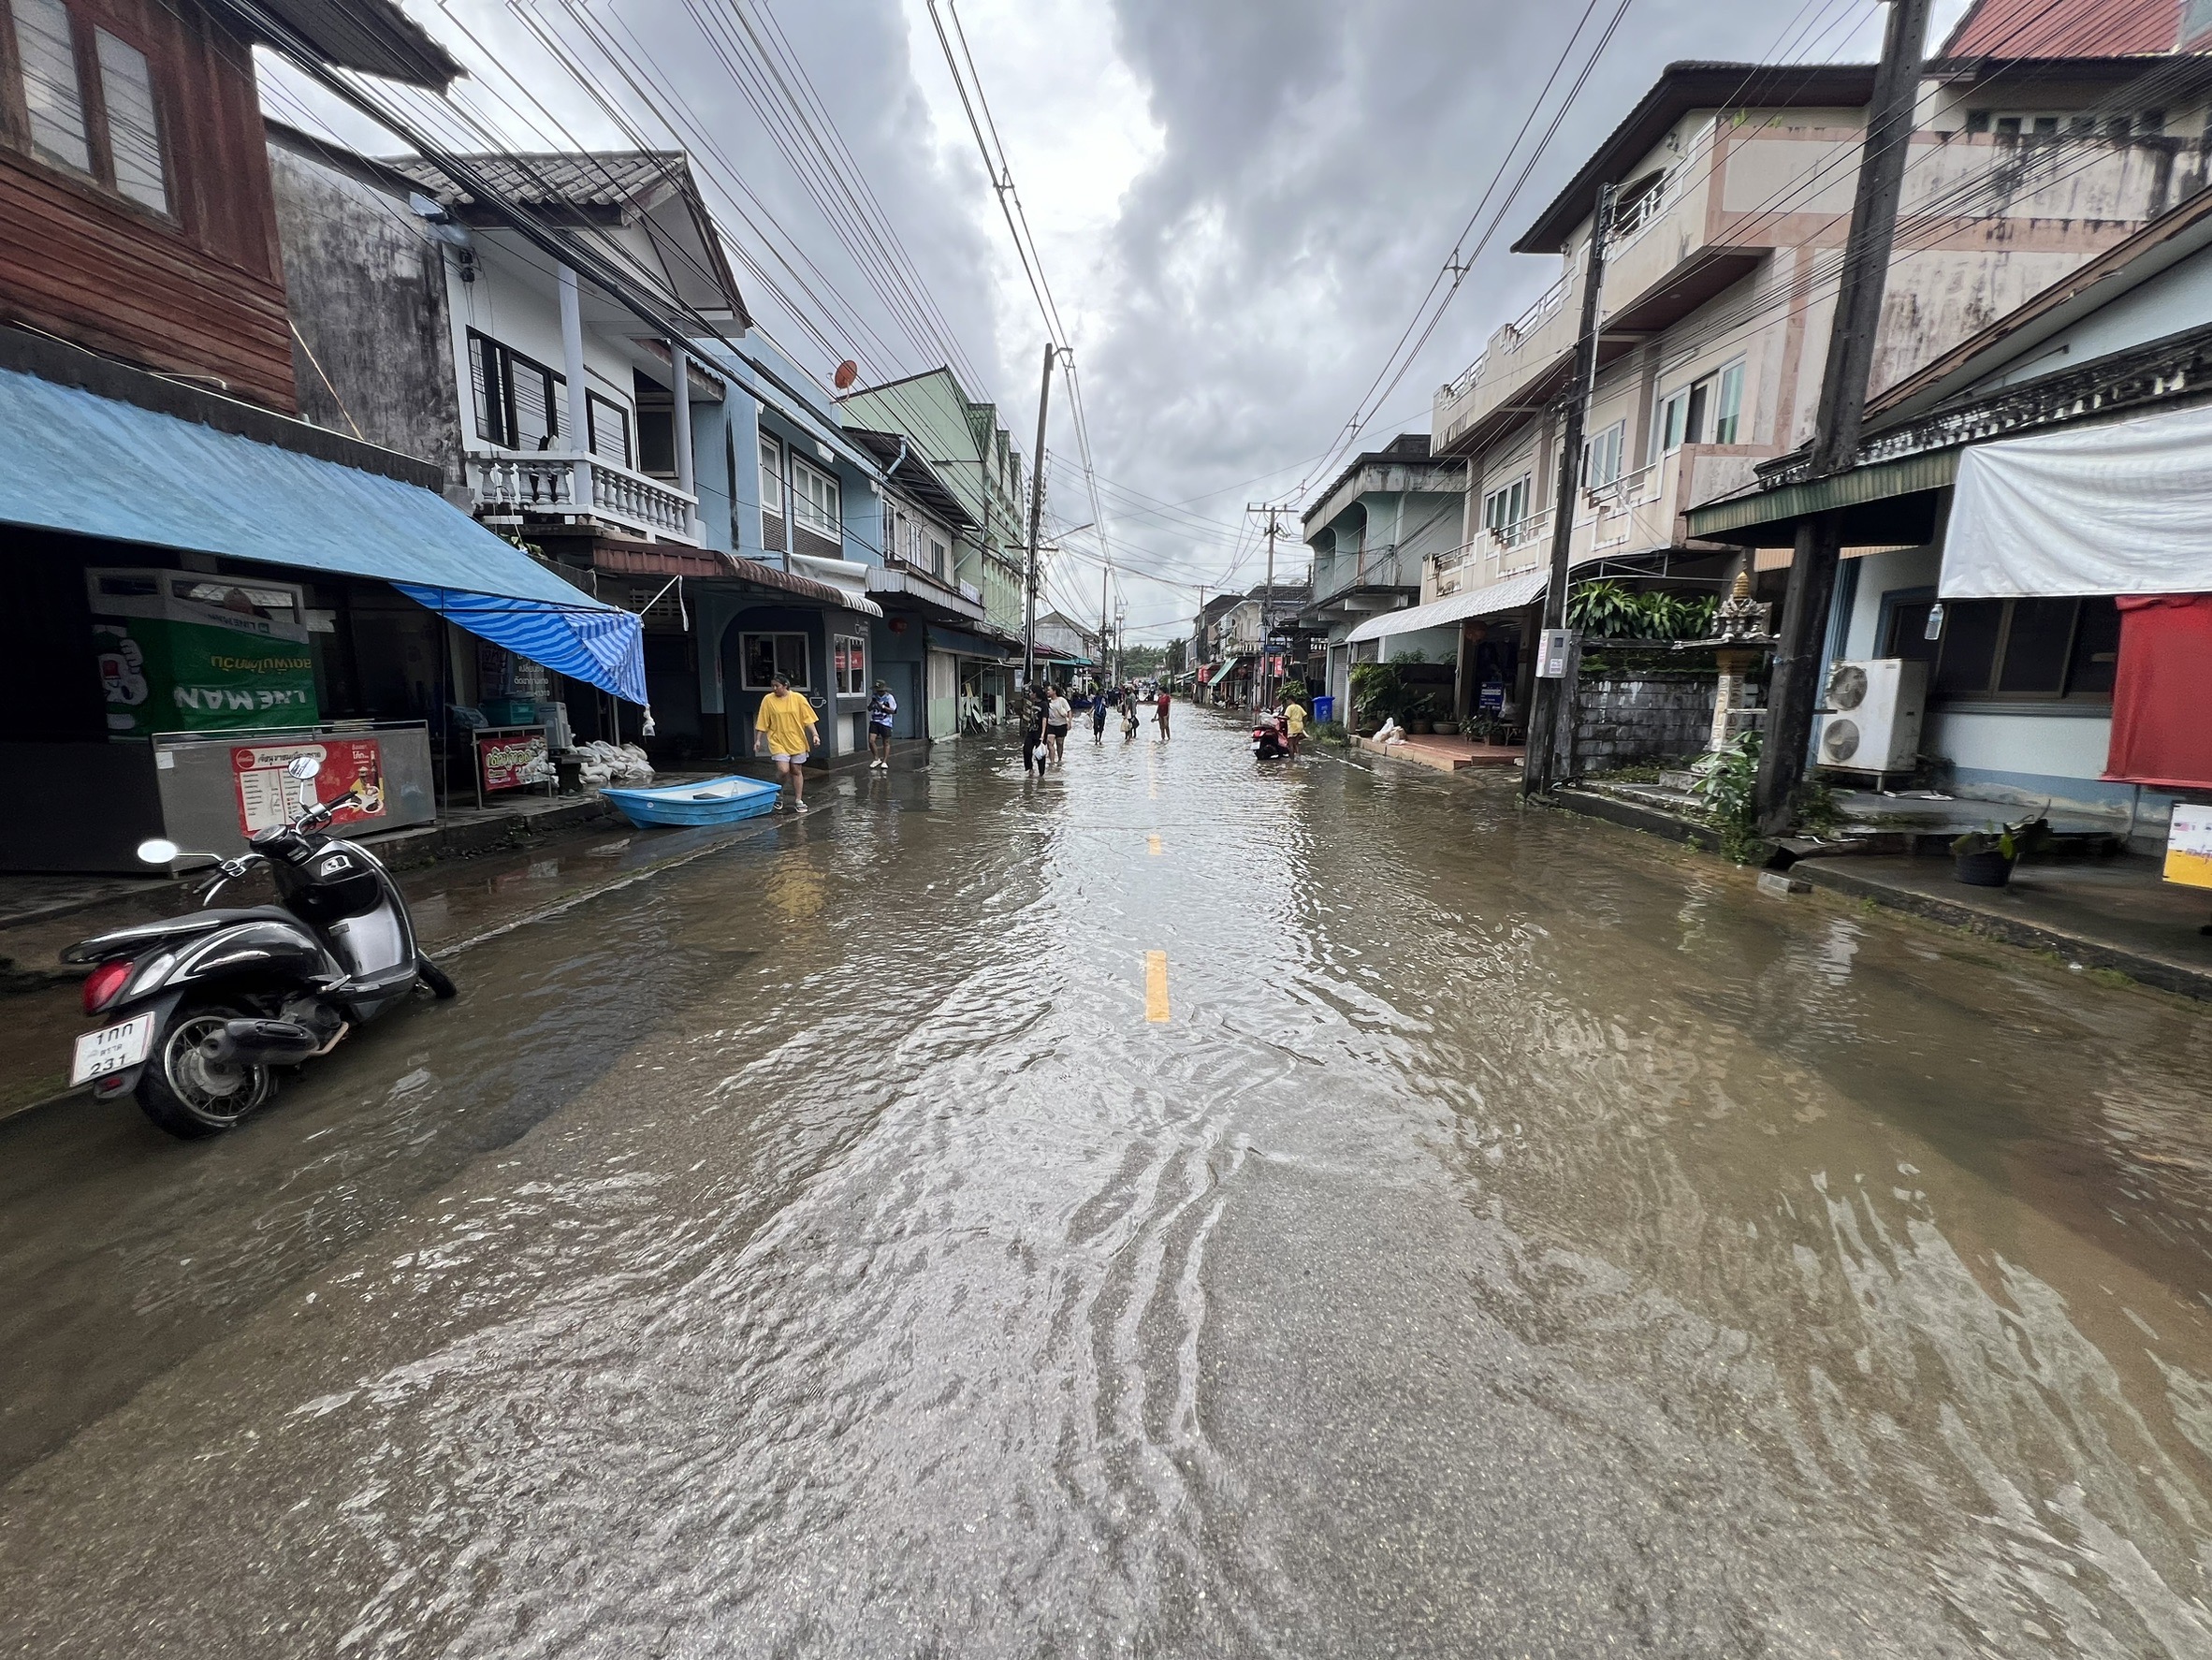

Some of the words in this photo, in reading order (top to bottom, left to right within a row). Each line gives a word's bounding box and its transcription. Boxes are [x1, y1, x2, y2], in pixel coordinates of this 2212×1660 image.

[174, 687, 254, 709] MAN
[97, 1024, 133, 1044] 1กก
[91, 1055, 125, 1076] 231
